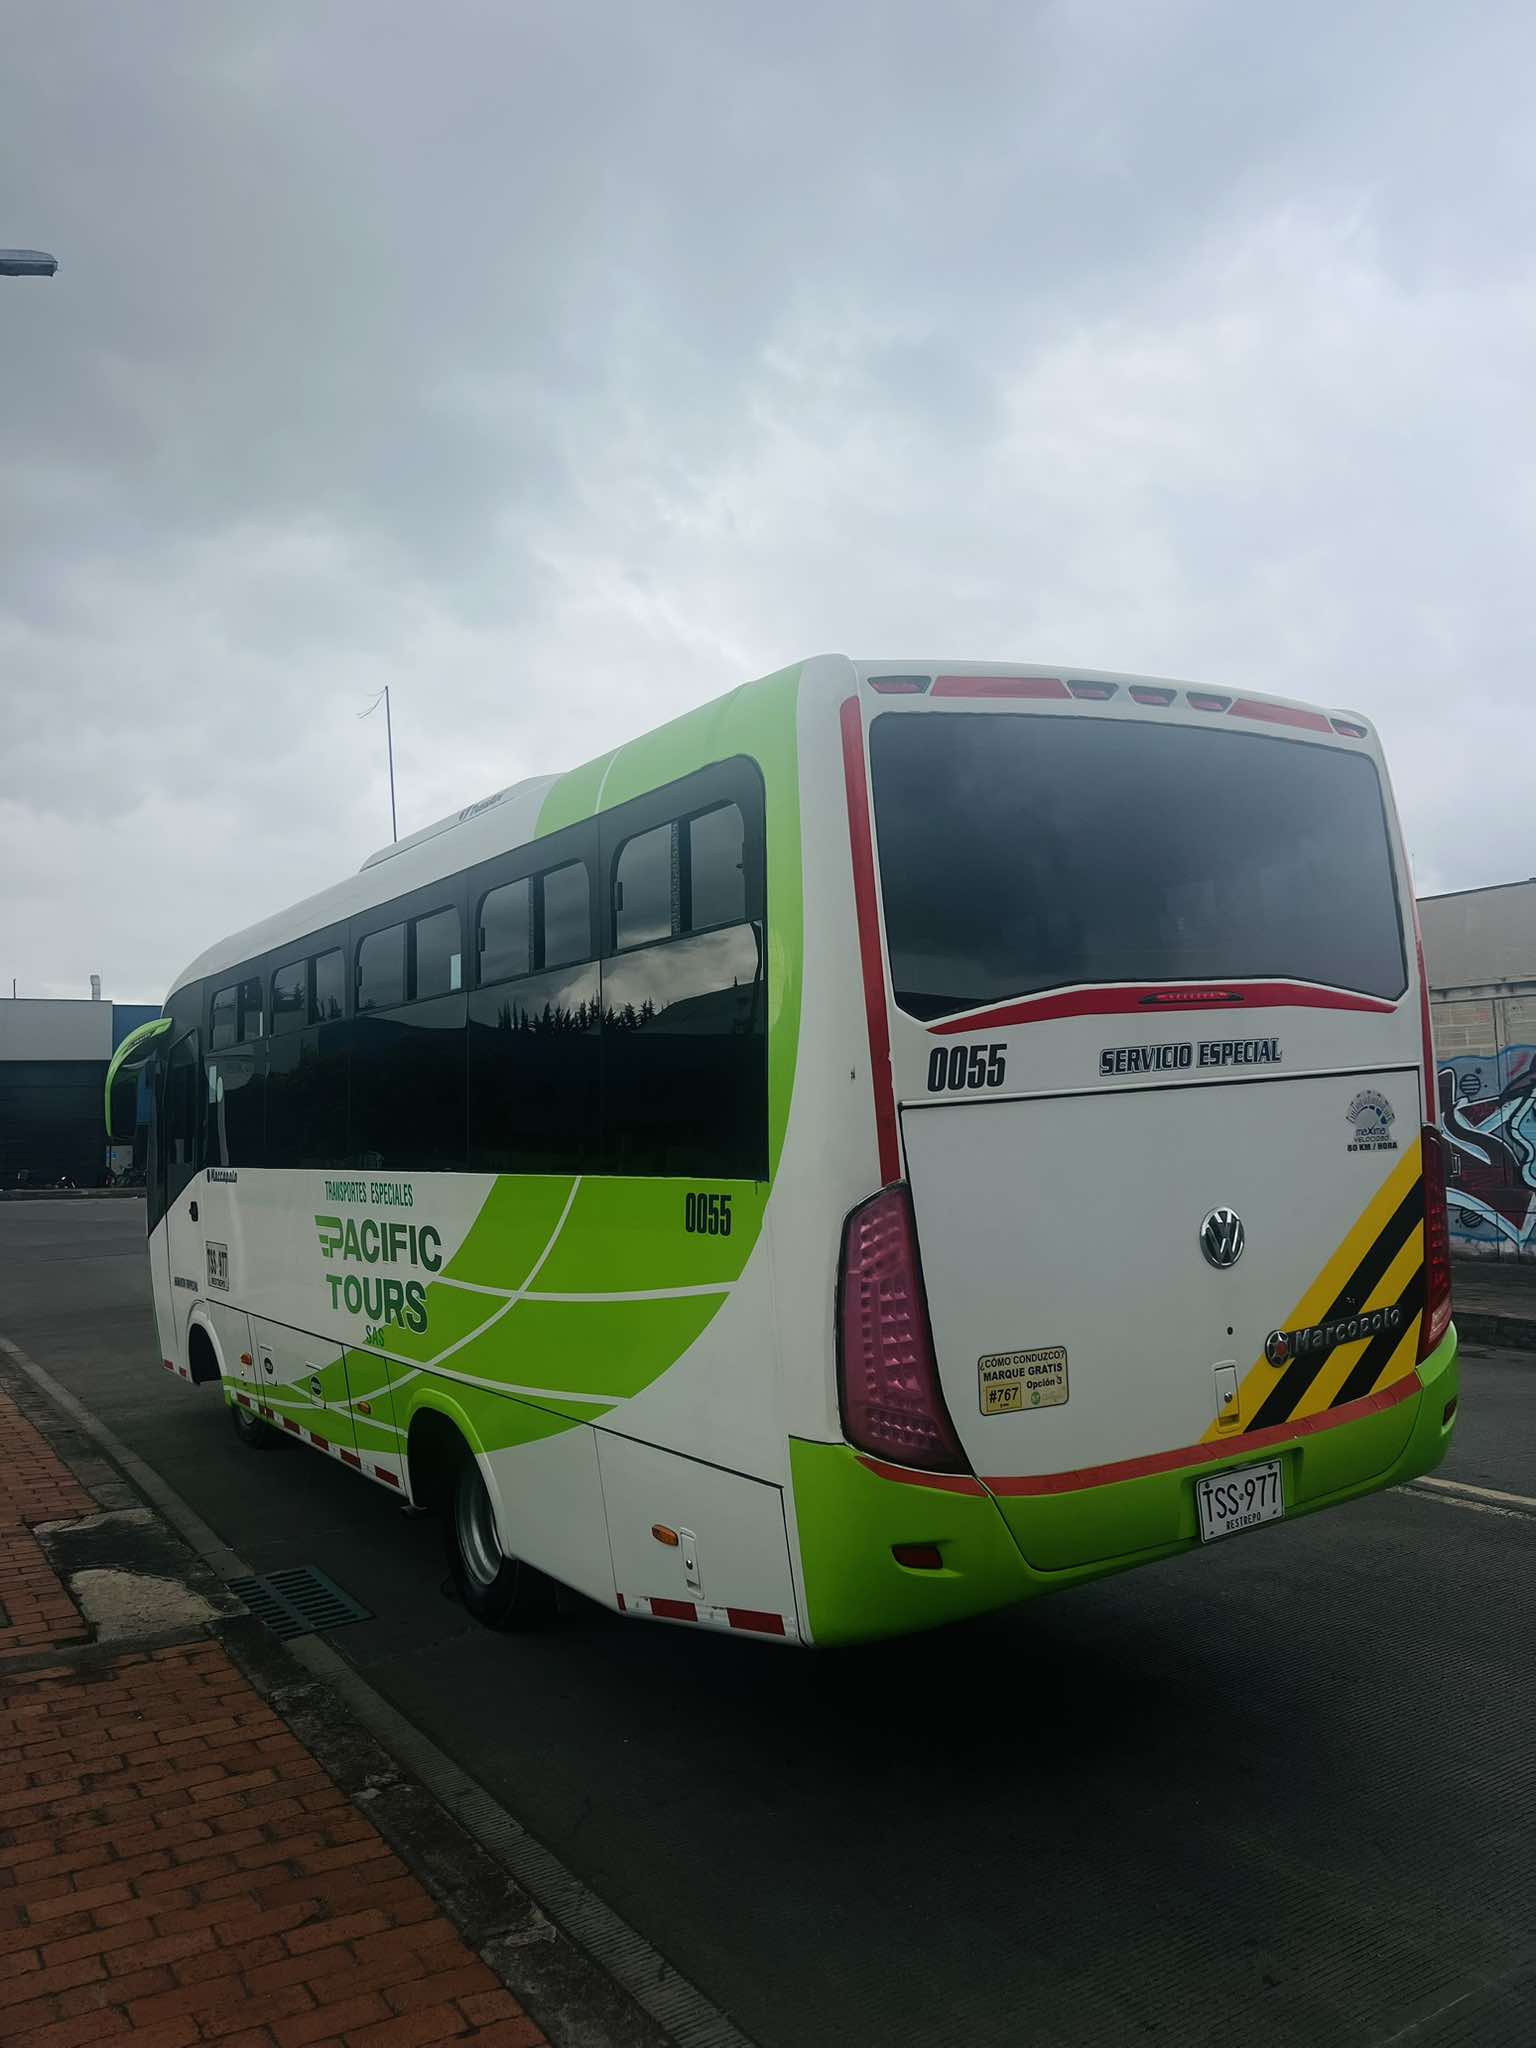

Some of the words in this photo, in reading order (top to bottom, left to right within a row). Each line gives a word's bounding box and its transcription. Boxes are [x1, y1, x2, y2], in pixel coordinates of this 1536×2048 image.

[927, 1043, 1008, 1092] 0055
[1100, 1042, 1193, 1077] SERVICIO
[1197, 1037, 1283, 1069] ESPECIAL
[325, 1180, 367, 1203] TRANSPORTES
[370, 1182, 414, 1208] ESPECIALES
[685, 1192, 732, 1237] 0055
[314, 1214, 443, 1273] PACIFIC
[326, 1273, 428, 1334] TOURS
[365, 1324, 385, 1347] SAS
[1294, 1307, 1401, 1353] Marcopolo
[1013, 1350, 1065, 1365] CONDUZCO?
[983, 1369, 1026, 1382] MARQUE
[1028, 1363, 1063, 1376] GRATIS
[1026, 1378, 1055, 1390] Opción
[988, 1386, 1019, 1404] #767
[1226, 1511, 1262, 1531] RESTREPO
